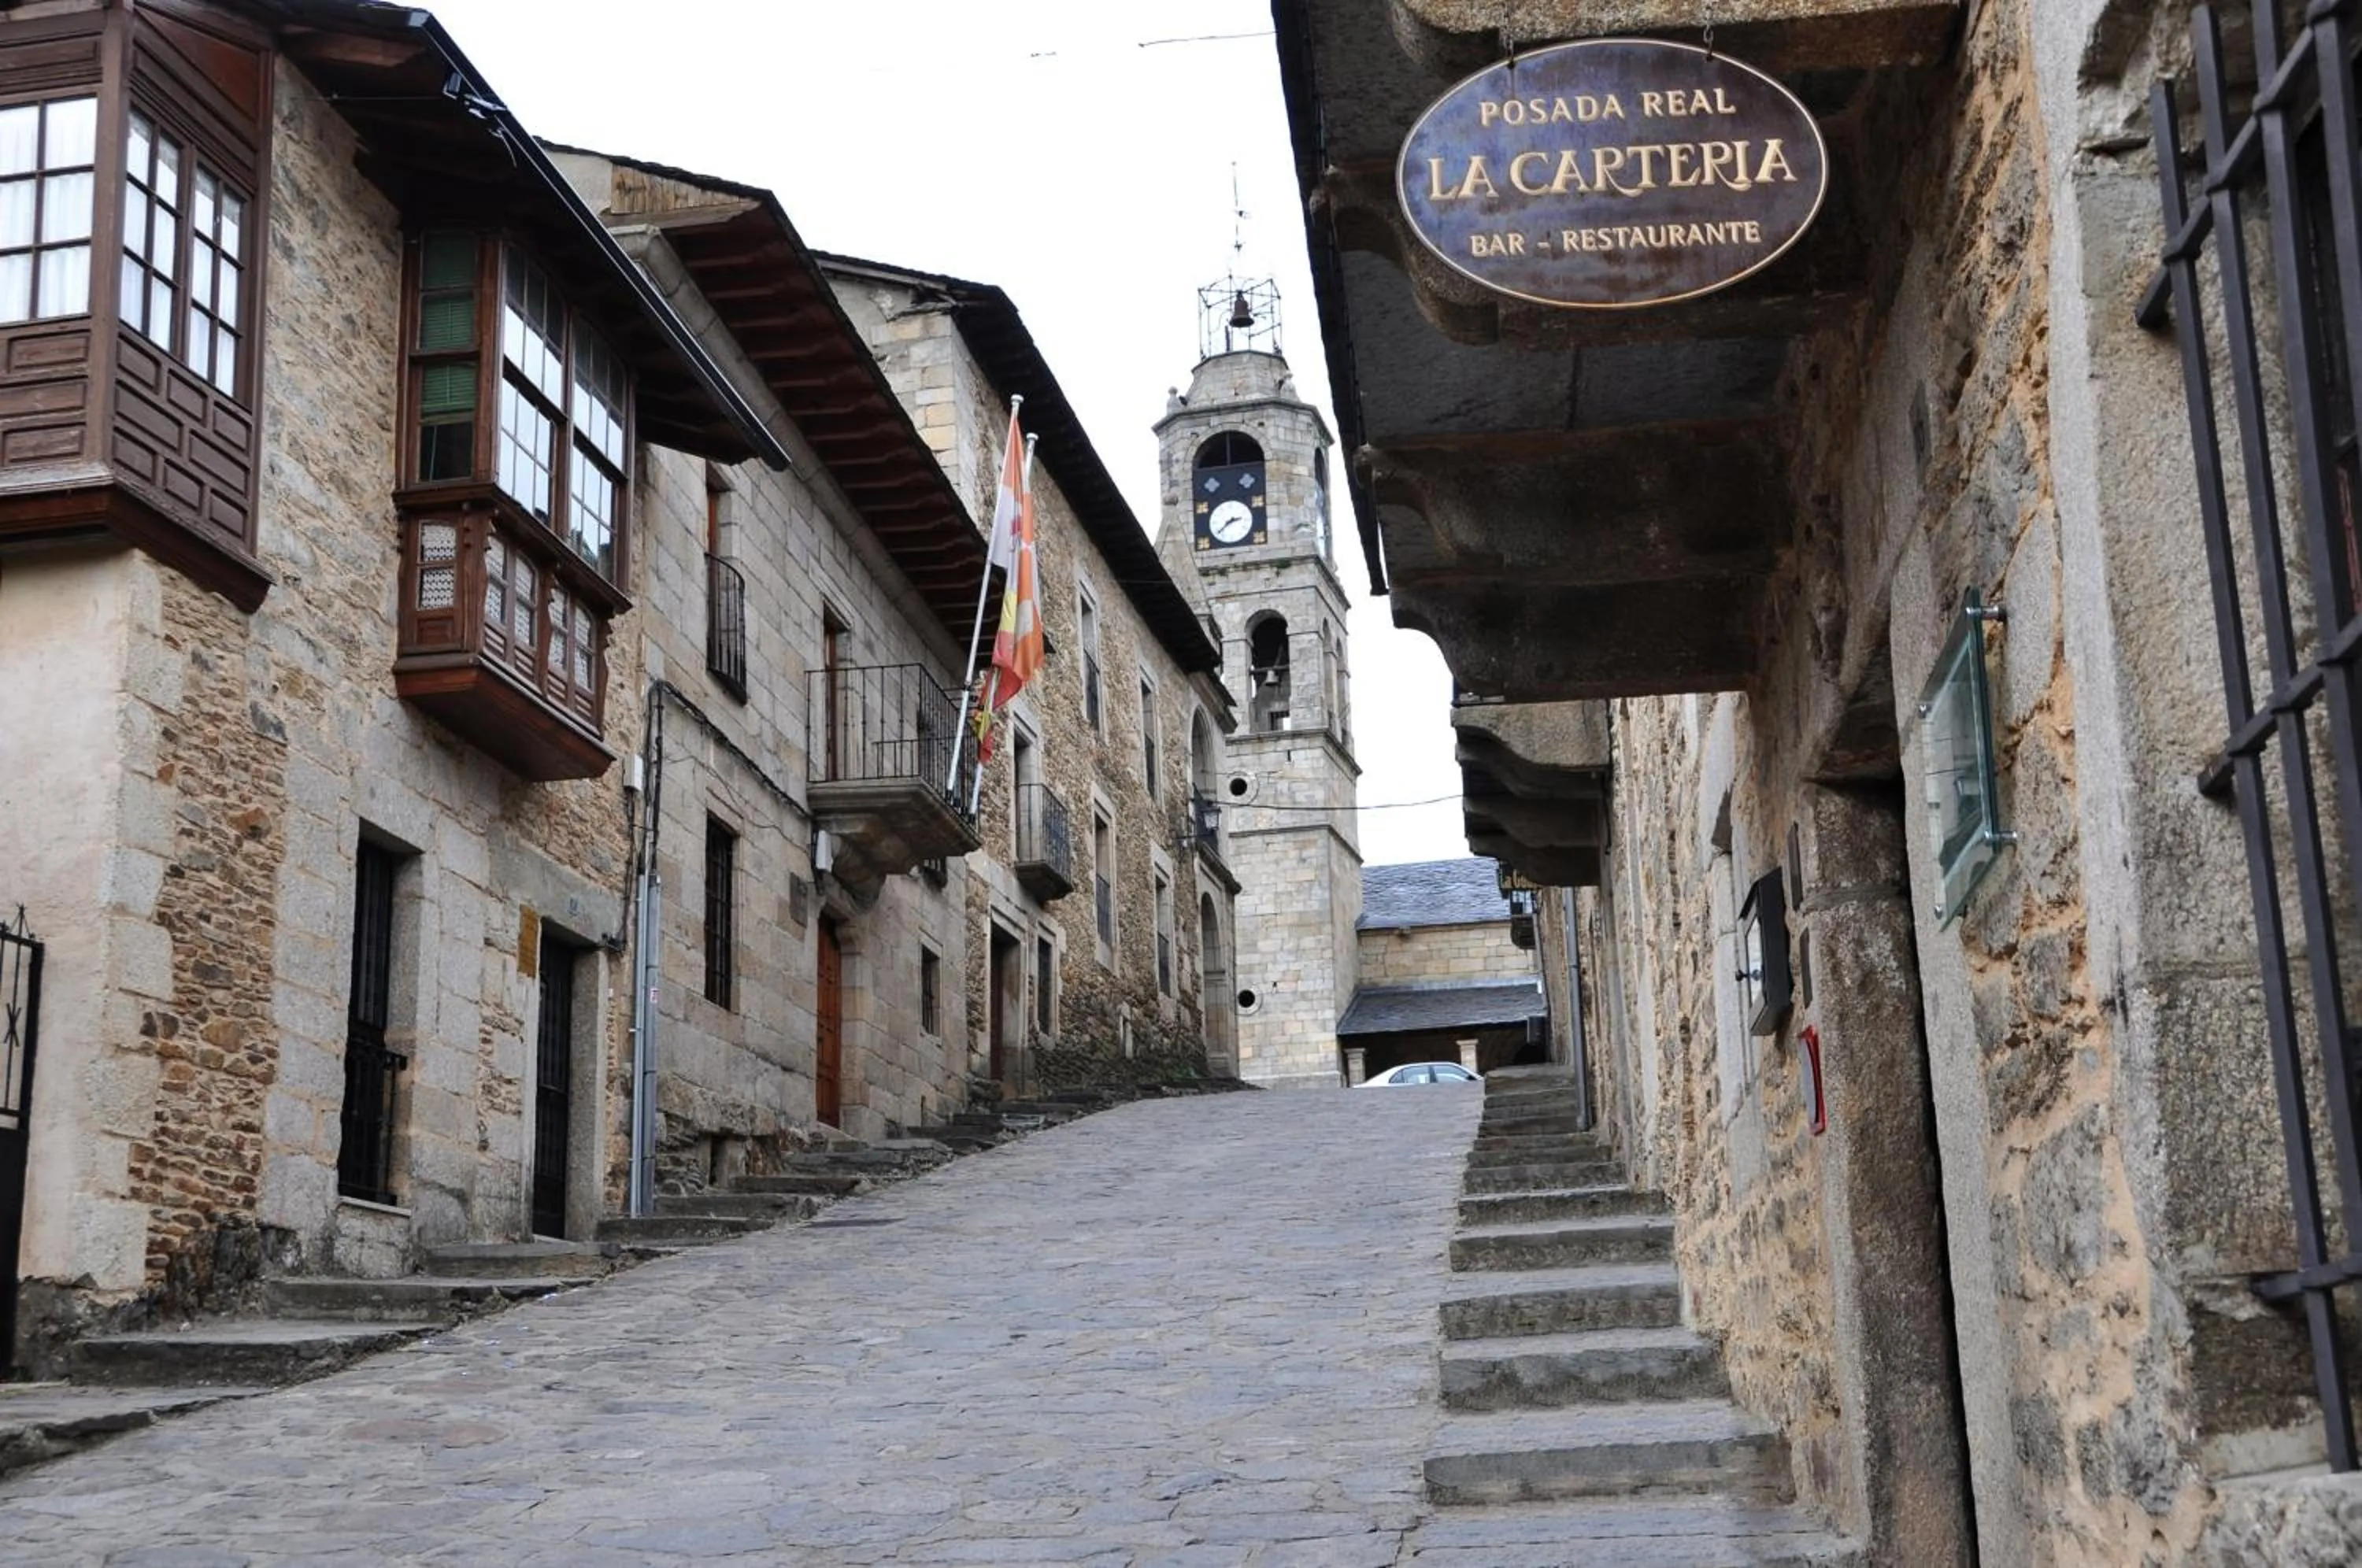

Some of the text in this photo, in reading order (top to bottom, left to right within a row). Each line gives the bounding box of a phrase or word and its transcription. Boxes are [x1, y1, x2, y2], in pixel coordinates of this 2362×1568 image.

[1479, 87, 1737, 127] POSADA REAL
[1428, 139, 1797, 202] LA CARTERIA
[1470, 232, 1526, 257] BAR
[1562, 220, 1762, 253] RESTAURANTE
